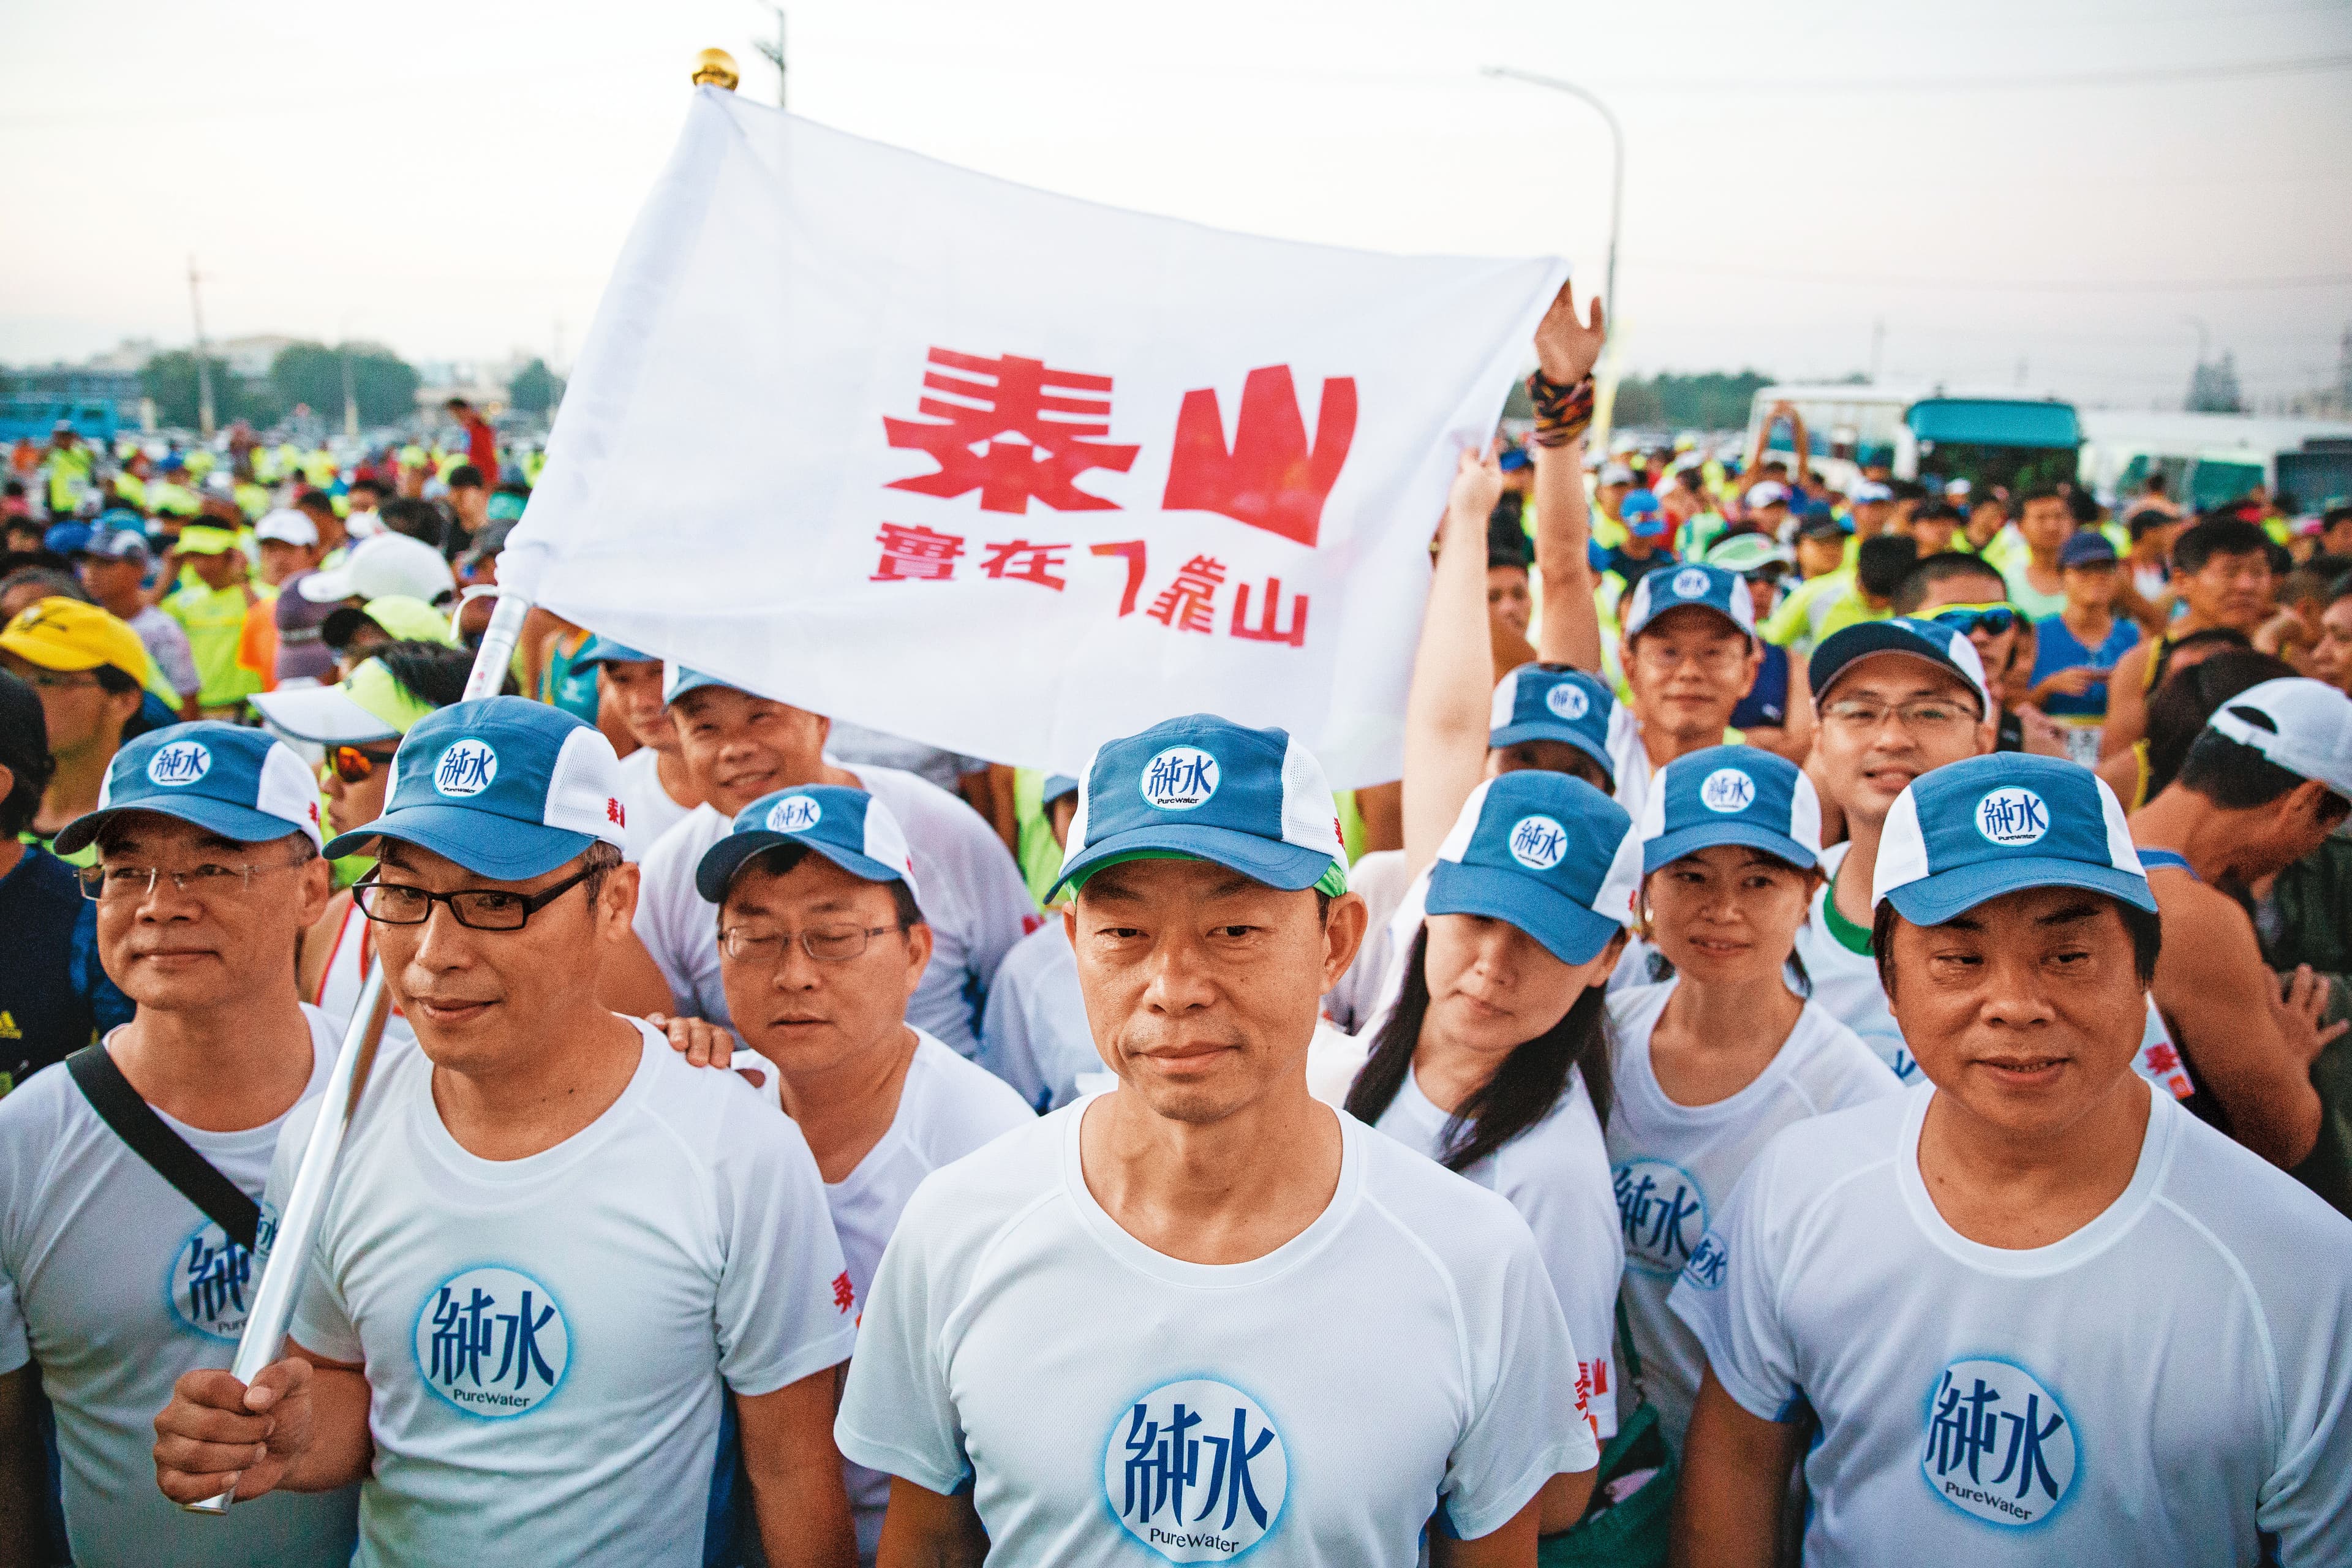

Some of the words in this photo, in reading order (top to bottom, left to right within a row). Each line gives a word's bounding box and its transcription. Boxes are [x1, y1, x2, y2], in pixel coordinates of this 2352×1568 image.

[882, 346, 1358, 548] 泰山
[154, 748, 207, 777] 純水
[438, 748, 494, 787] 純水
[1147, 755, 1213, 797] 純水
[1984, 794, 2046, 835] 純水
[1513, 820, 1566, 862] 純水
[188, 1237, 251, 1322] 純
[429, 1287, 556, 1390] 純水
[453, 1389, 530, 1408] PureWater
[1925, 1370, 2064, 1501] 純水
[1123, 1404, 1275, 1531] 純水
[1945, 1481, 2032, 1521] PureWater
[1150, 1528, 1240, 1553] PureWater
